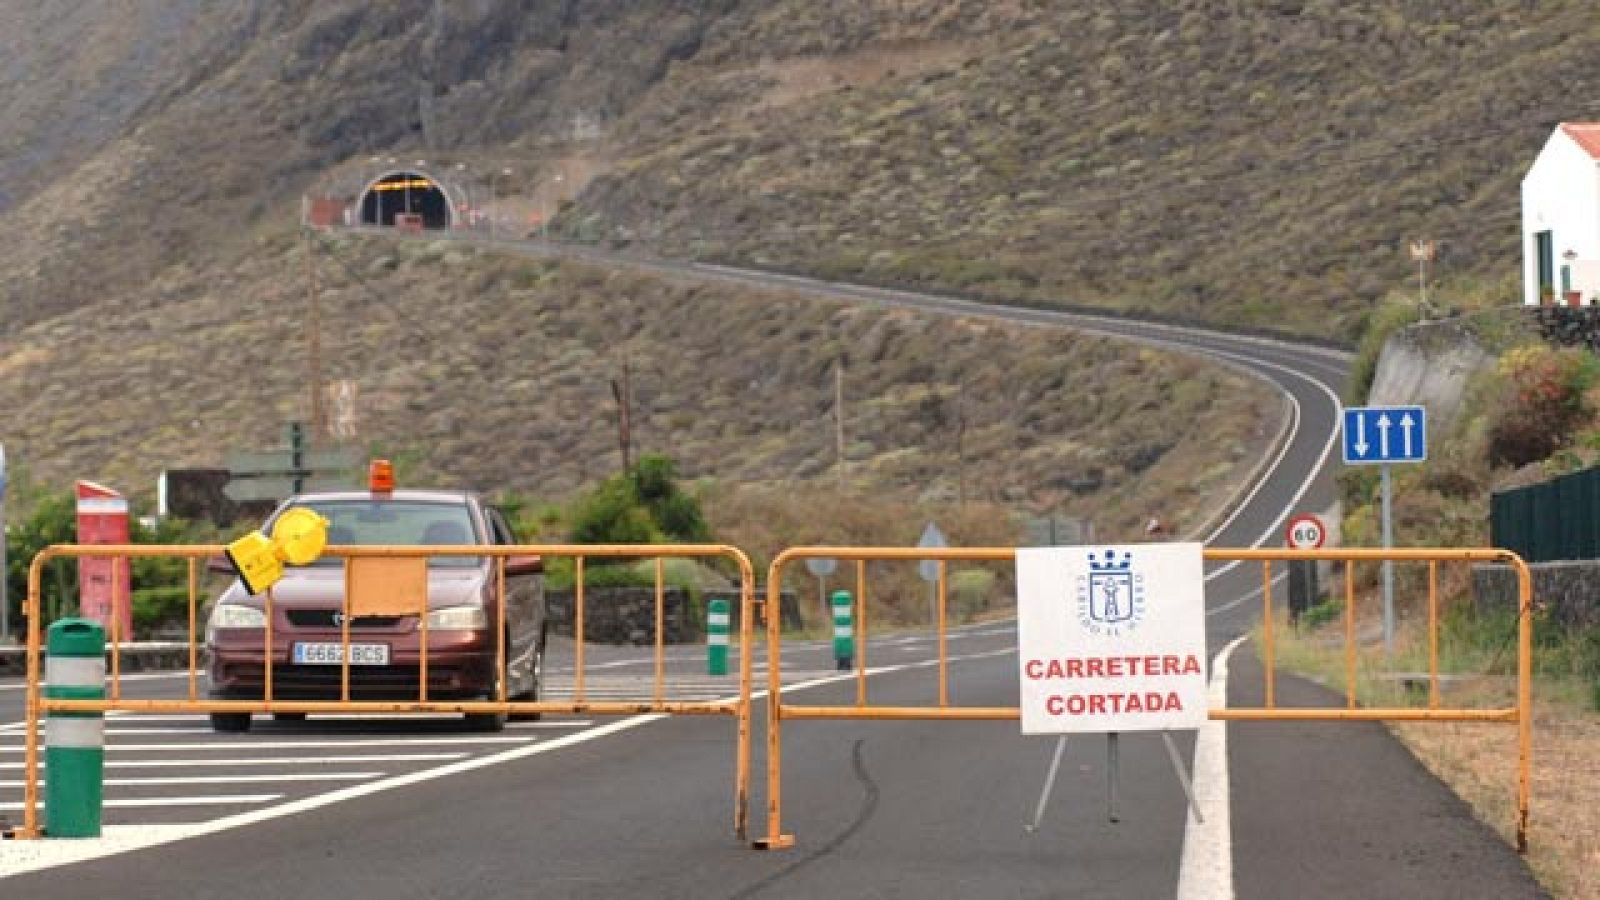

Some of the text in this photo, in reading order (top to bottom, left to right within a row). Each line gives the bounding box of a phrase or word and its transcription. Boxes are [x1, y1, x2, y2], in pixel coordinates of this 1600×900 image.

[1294, 528, 1318, 543] 60
[1025, 654, 1201, 680] CARRETERA
[1046, 691, 1183, 716] CORTADA
